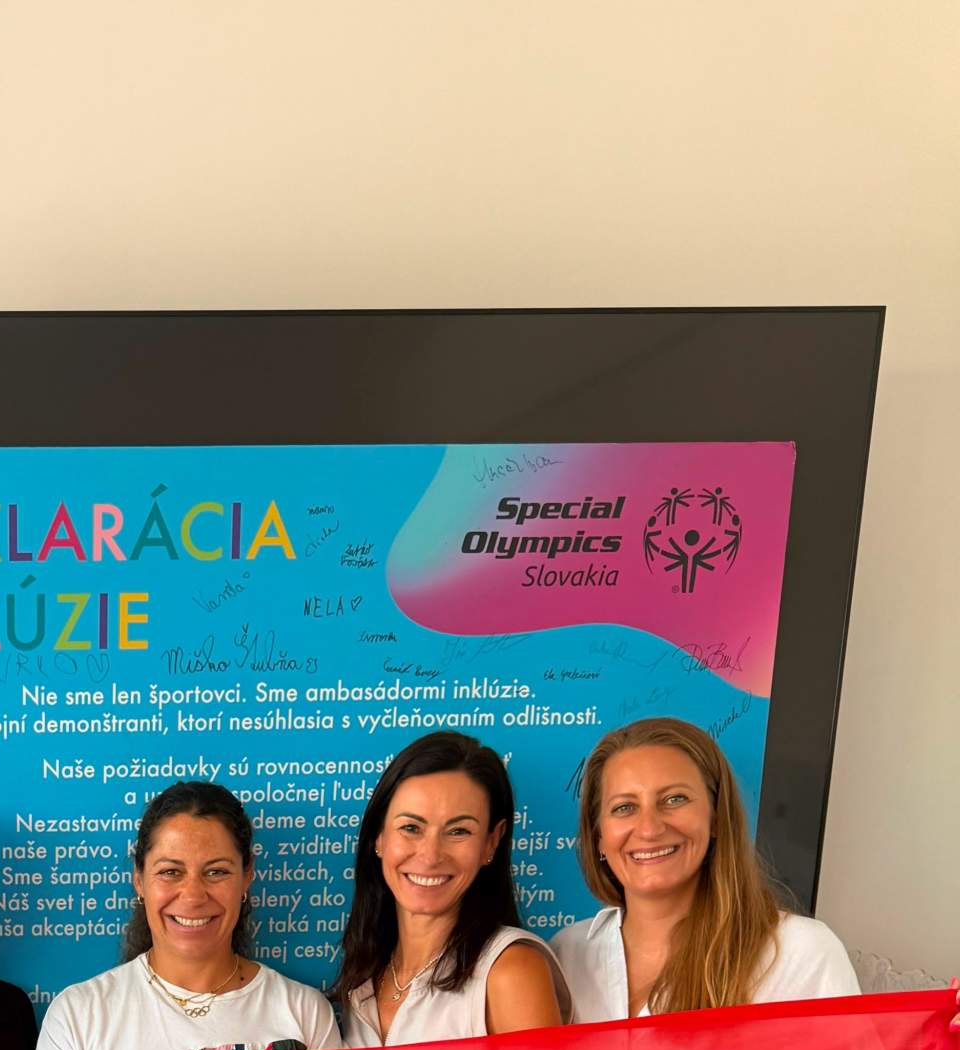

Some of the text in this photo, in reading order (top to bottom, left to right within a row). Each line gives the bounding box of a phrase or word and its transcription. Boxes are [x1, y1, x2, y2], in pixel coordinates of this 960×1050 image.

[496, 497, 626, 523] Special
[461, 531, 621, 559] Olympics
[521, 566, 620, 588] Slovakia
[303, 595, 344, 617] NELA
[22, 678, 536, 710] Nie sme len športovci. Sme ambasádormi inklúzie.
[33, 712, 169, 736] demonštranti,
[177, 710, 222, 731] ktorí
[229, 709, 334, 731] nesúhlasia
[341, 713, 350, 729] s
[358, 707, 495, 734] vyčleňovaním
[503, 705, 602, 727] odlišnosti.
[42, 758, 95, 780] Naše
[103, 756, 222, 784] požiadavky
[228, 757, 249, 777] sú
[124, 793, 137, 805] a
[253, 809, 306, 829] deme
[2, 840, 48, 860] naše
[55, 839, 118, 865] právo.
[2, 867, 43, 886] Sme
[50, 866, 132, 890] šampión
[37, 894, 74, 911] svet
[80, 892, 97, 916] je
[309, 887, 346, 907] ako
[269, 914, 309, 933] taká
